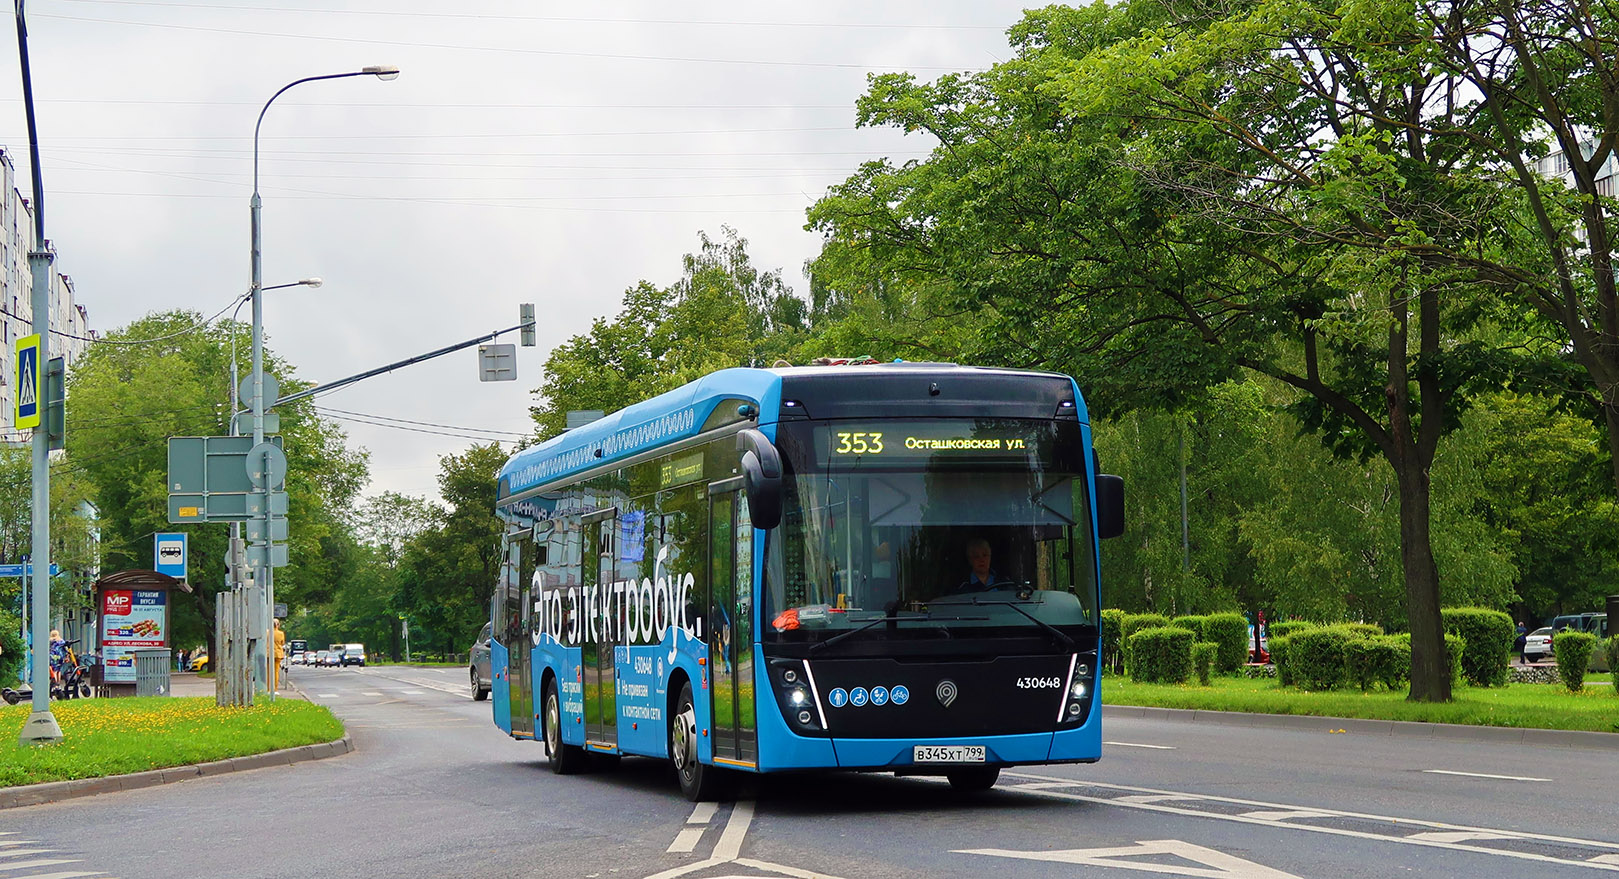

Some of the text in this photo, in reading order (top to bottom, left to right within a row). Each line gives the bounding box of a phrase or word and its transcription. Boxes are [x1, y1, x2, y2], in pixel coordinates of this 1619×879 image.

[836, 432, 1025, 454] 353 Осташковская ул.
[662, 465, 672, 485] 353
[532, 545, 702, 665] Это электробус.
[634, 656, 653, 675] 430648
[621, 680, 628, 696] Не
[1016, 677, 1061, 689] 430648
[917, 747, 982, 760] В345ХТ 799
